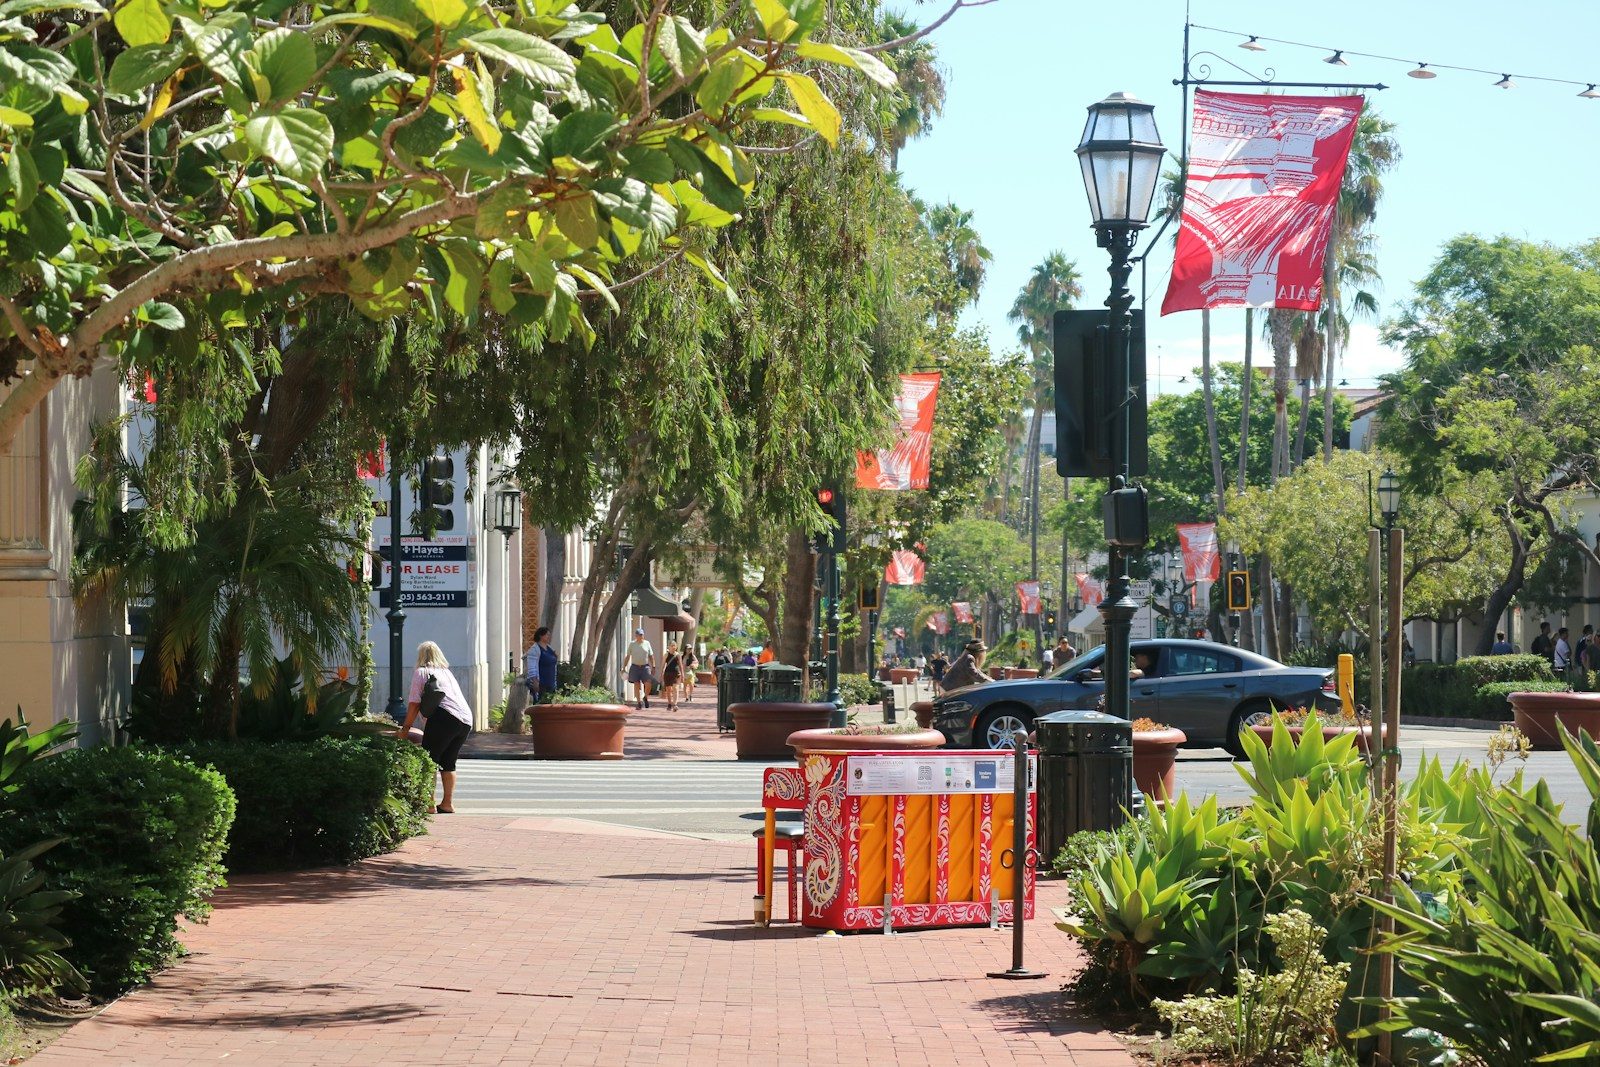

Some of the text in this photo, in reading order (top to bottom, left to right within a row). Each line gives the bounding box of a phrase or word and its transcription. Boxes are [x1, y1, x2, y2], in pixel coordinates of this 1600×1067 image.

[412, 546, 444, 556] Hayes
[386, 565, 460, 574] FR LEASE
[400, 593, 455, 601] 05) 563-2111
